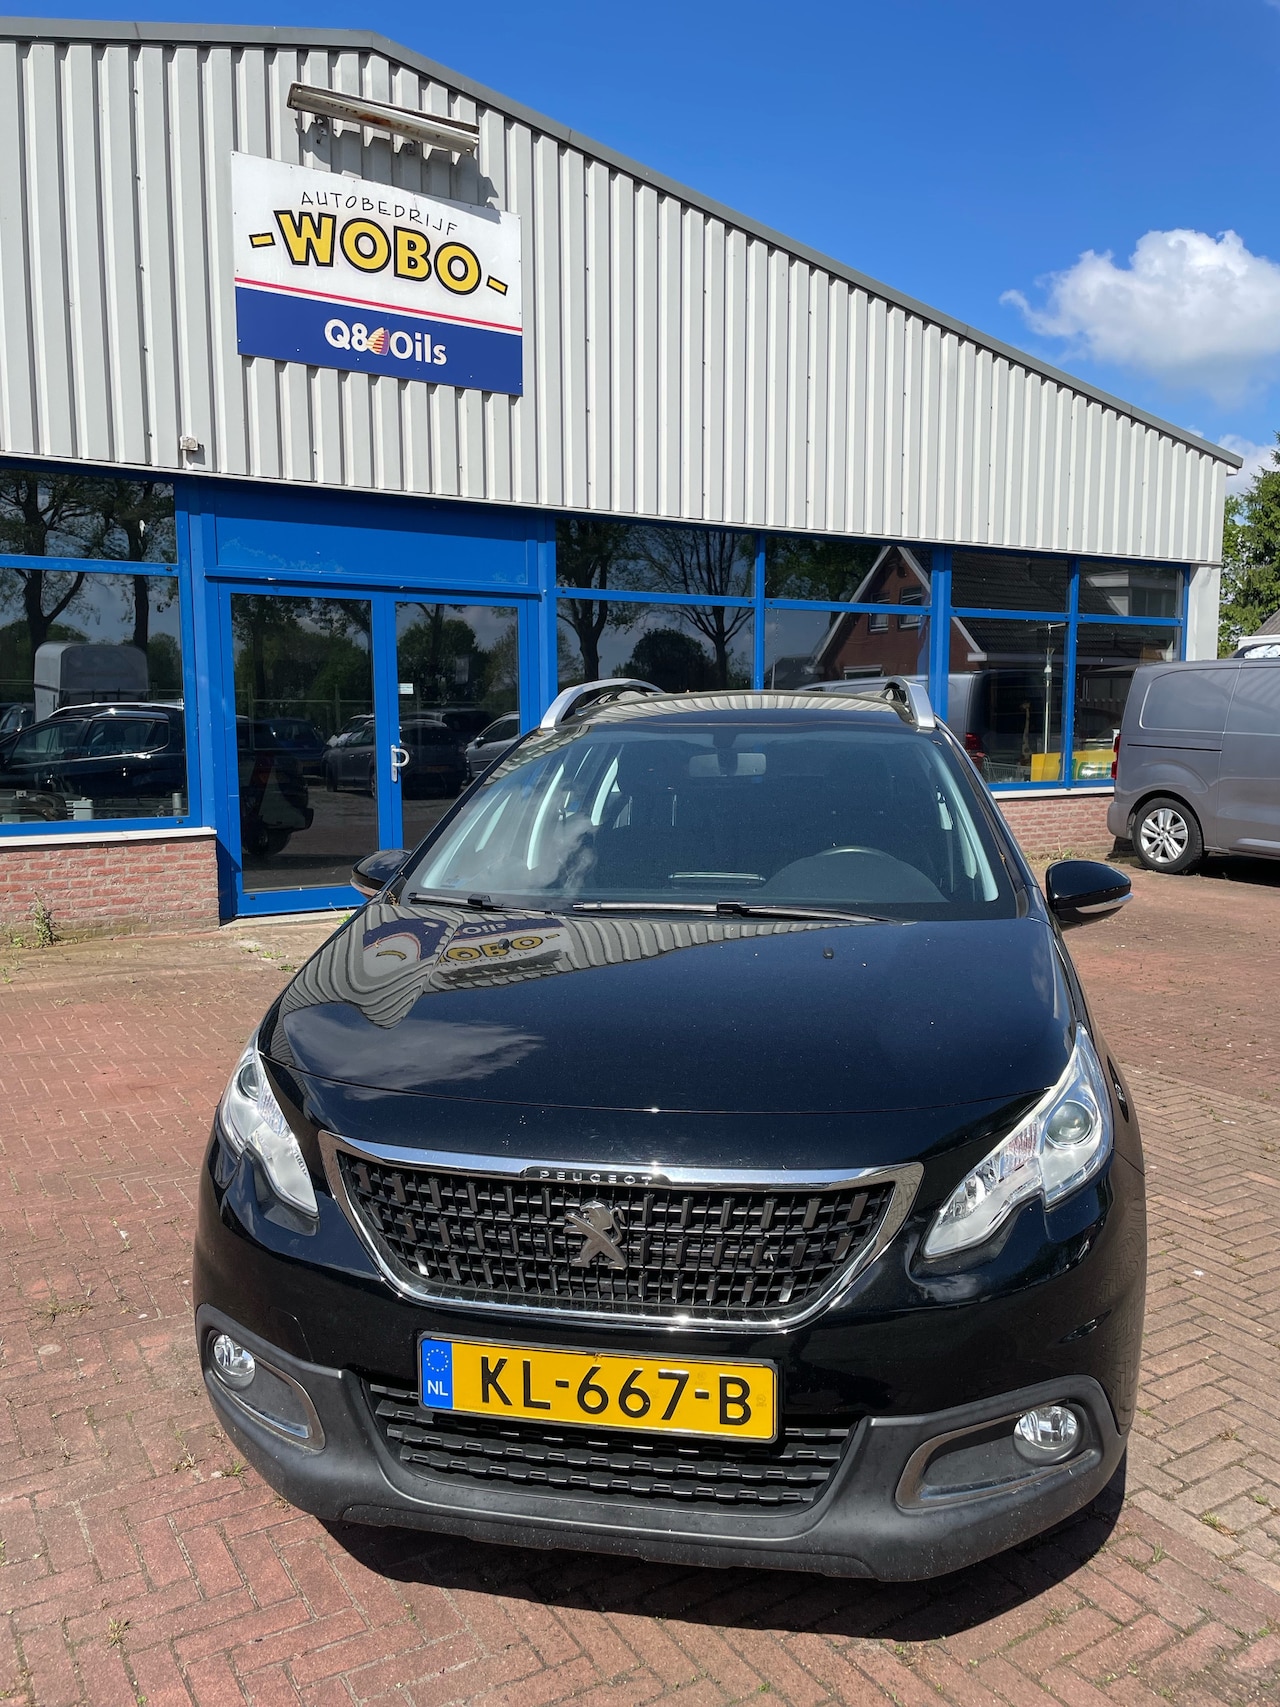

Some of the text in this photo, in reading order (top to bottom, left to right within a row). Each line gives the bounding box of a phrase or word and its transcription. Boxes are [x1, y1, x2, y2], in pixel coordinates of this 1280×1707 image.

[301, 191, 457, 236] AUTOBEDRIJF
[324, 318, 447, 366] Q8 Oils
[539, 1170, 652, 1186] PEUGEOT
[427, 1380, 449, 1397] NL
[480, 1355, 752, 1426] KL-667-B
